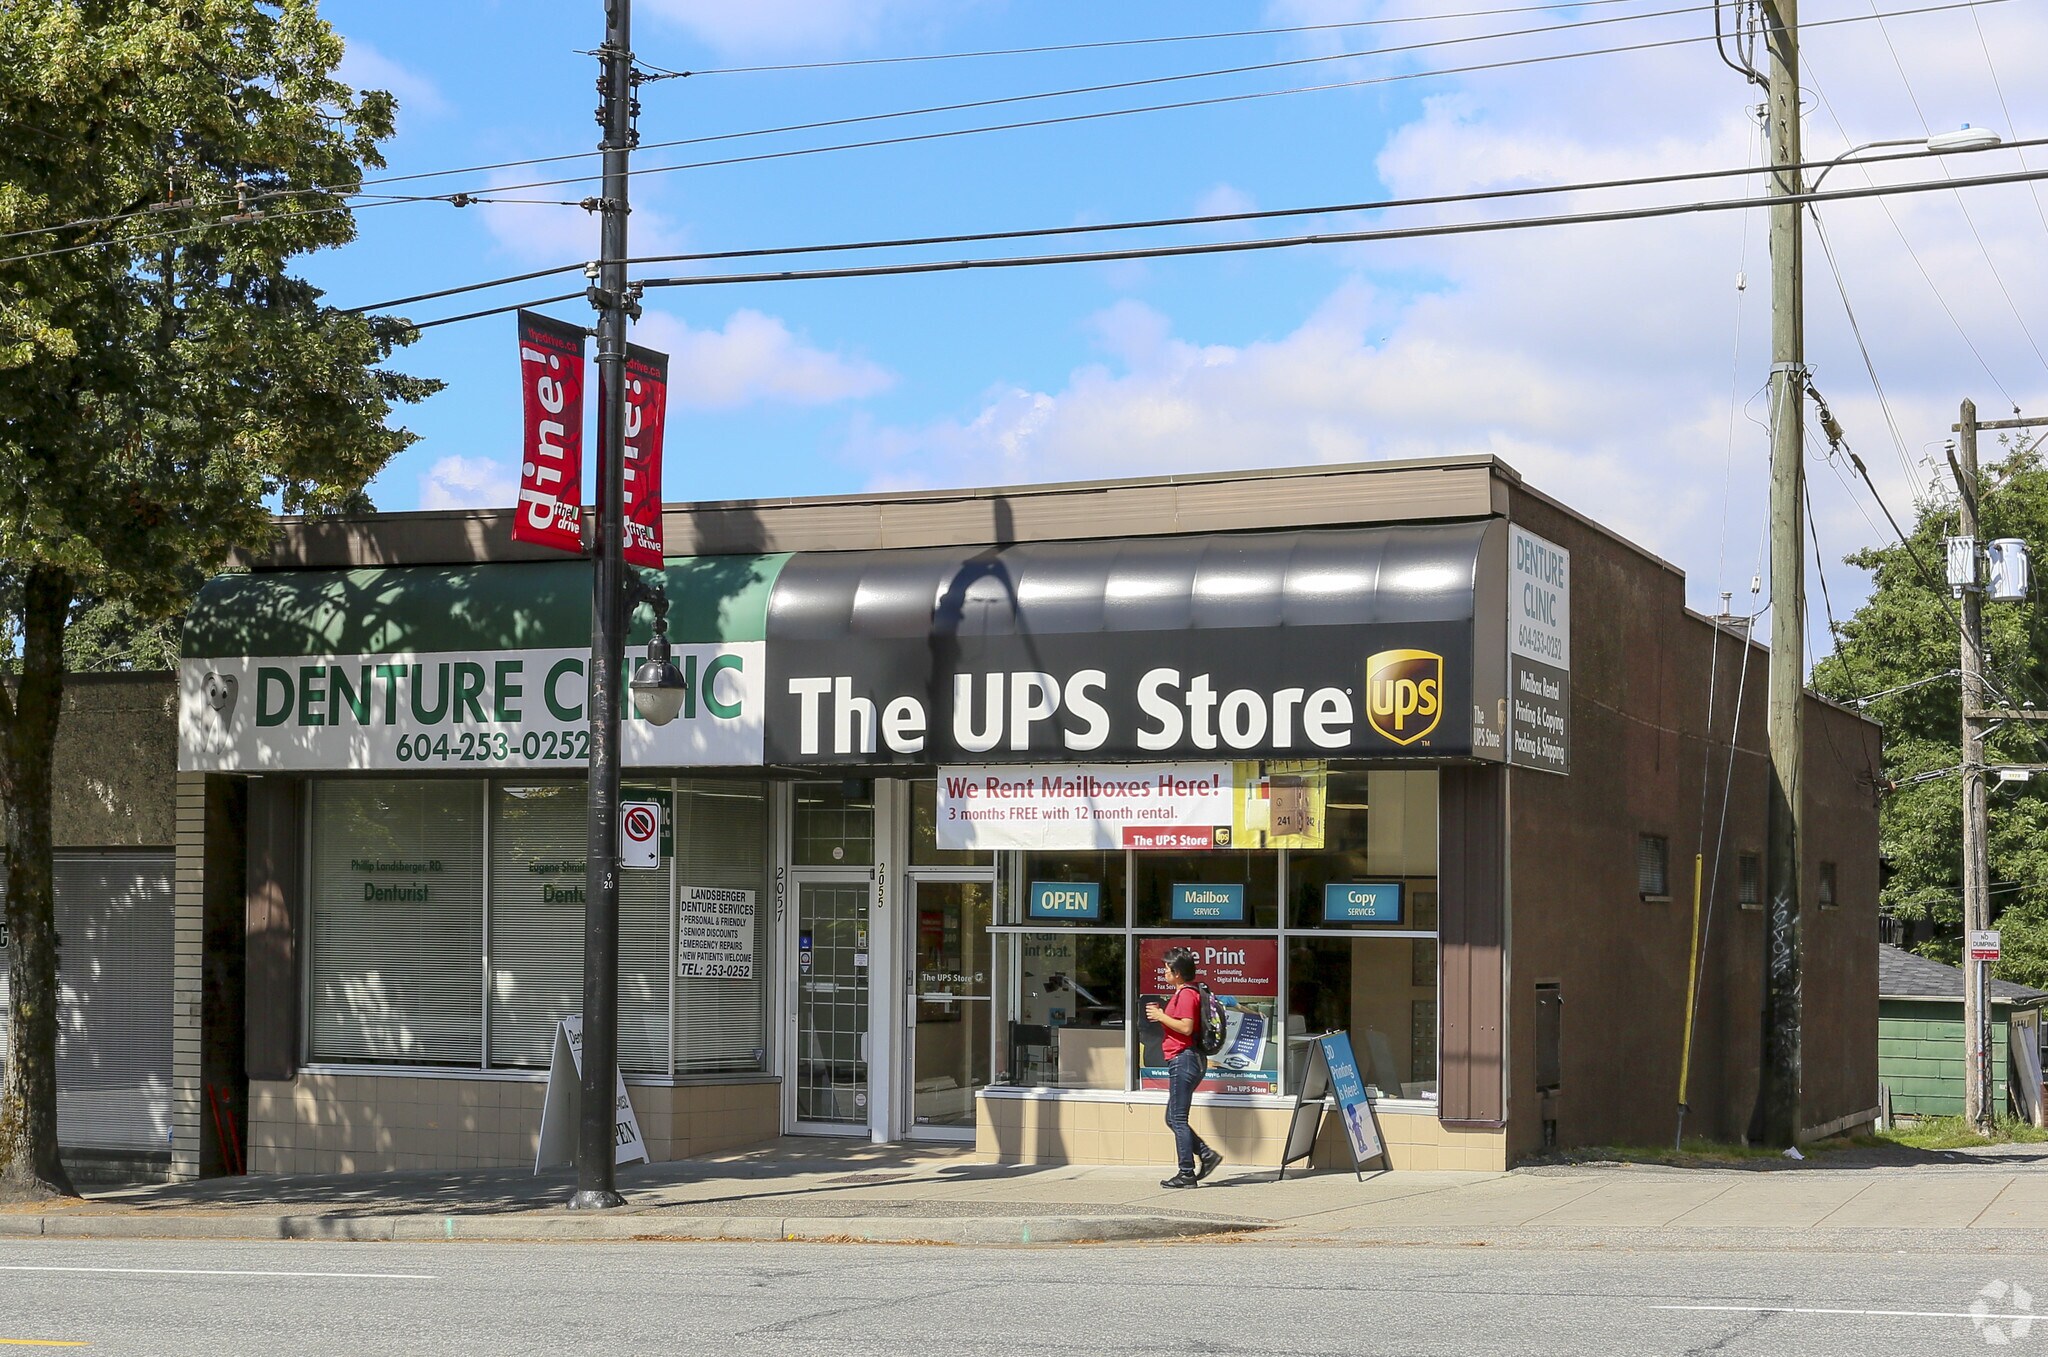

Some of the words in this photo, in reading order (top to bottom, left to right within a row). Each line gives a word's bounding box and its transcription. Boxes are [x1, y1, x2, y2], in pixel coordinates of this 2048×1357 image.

[528, 327, 578, 353] thedrive.ca
[520, 347, 565, 530] dine!
[558, 516, 580, 534] drive
[638, 535, 661, 552] drive
[1516, 536, 1564, 590] DENTURE
[1523, 582, 1557, 628] CLINIC
[255, 659, 523, 728] DENTURE
[1520, 670, 1542, 696] Mailbox
[1542, 677, 1560, 701] Rental
[789, 676, 927, 755] The
[953, 669, 1111, 754] UPS
[1136, 668, 1353, 751] Store
[1372, 678, 1438, 730] ups
[1474, 705, 1484, 724] The
[1515, 699, 1536, 729] Printing
[1536, 707, 1542, 726] &
[1542, 707, 1564, 736] Copying
[396, 730, 590, 762] 604-253-0252
[1474, 728, 1486, 747] UPS
[1486, 729, 1500, 748] Store
[1514, 730, 1536, 760] Packing
[1536, 736, 1542, 755] &
[1542, 736, 1564, 766] Shipping
[946, 777, 978, 799] We
[986, 776, 1034, 798] Rent
[1041, 775, 1150, 798] Mailboxes
[1158, 774, 1220, 797] Here!
[948, 808, 956, 820] 3
[960, 807, 1006, 820] months
[1010, 807, 1038, 820] FREE
[1042, 806, 1069, 820] with
[1075, 806, 1088, 820] 12
[1093, 806, 1133, 820] month
[1137, 806, 1178, 819] rental.
[1277, 816, 1290, 826] 241
[1133, 835, 1153, 846] The
[1156, 834, 1176, 846] UPS
[1180, 834, 1208, 846] Store
[376, 860, 427, 874] Landsberger,
[529, 861, 559, 874] Eugene
[606, 872, 612, 881] 9
[878, 862, 886, 908] 2055
[364, 882, 429, 901] Denturist
[690, 888, 746, 902] LANDSBERGER
[776, 866, 784, 922] 2057
[1041, 891, 1088, 910] OPEN
[1184, 890, 1230, 904] Mailbox
[1348, 890, 1376, 906] Copy
[682, 901, 717, 913] DENTURE
[718, 903, 754, 915] SERVICES
[1193, 907, 1220, 916] SERVICES
[1347, 907, 1376, 916] SERVICES
[684, 915, 714, 925] PERSONAL
[716, 918, 720, 926] &
[720, 918, 747, 927] FRIENDLY
[683, 927, 705, 937] SENIOR
[706, 928, 738, 938] DISCOUNTS
[683, 940, 719, 950] EMERGENCY
[719, 941, 743, 951] REPAIRS
[1044, 944, 1072, 957] that.
[682, 952, 696, 961] NEW
[697, 952, 724, 962] PATIENTS
[724, 953, 752, 963] WELCOME
[1205, 946, 1246, 965] Print
[682, 963, 703, 976] TEL:
[706, 964, 750, 977] 253-0252
[922, 973, 936, 982] The
[937, 973, 952, 982] UPS
[953, 974, 972, 983] Store
[1330, 1062, 1355, 1081] Printing
[1344, 1080, 1360, 1098] Here!
